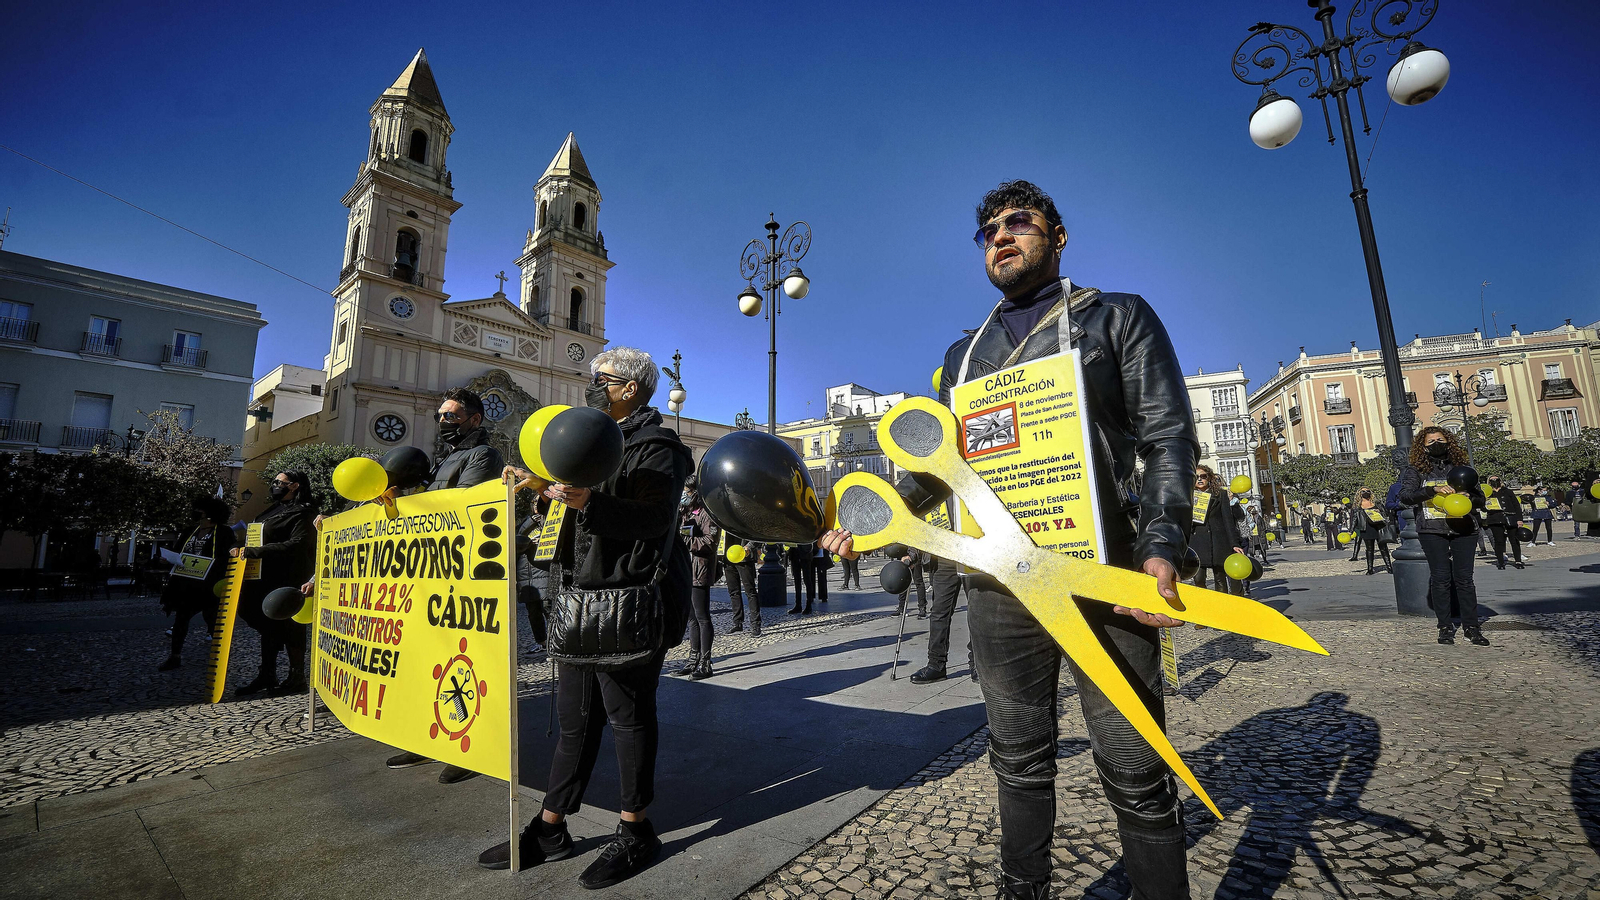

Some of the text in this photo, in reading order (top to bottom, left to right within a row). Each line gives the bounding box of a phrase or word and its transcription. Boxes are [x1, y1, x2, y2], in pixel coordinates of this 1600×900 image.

[985, 370, 1026, 392] CÁDIZ
[970, 378, 1054, 410] CONCENTRACIÓN
[1036, 391, 1073, 404] noviembre
[1053, 402, 1073, 410] Antonio
[1020, 420, 1038, 428] Frente
[1060, 411, 1077, 419] PSOE
[1032, 429, 1053, 441] 11h
[1019, 455, 1060, 469] restitución
[1062, 452, 1075, 460] del
[1018, 468, 1045, 478] imagen
[1047, 461, 1082, 475] personal
[1030, 478, 1045, 486] PGE
[1046, 475, 1059, 484] del
[1061, 472, 1081, 482] 2022
[1047, 493, 1080, 504] Estética
[1013, 506, 1064, 519] ESENCIALES
[410, 510, 465, 534] PERSONAL
[1026, 518, 1076, 533] 10% YA
[1059, 539, 1089, 550] personal
[370, 534, 465, 580] NOSOTROS
[338, 583, 348, 607] EL
[361, 583, 373, 610] AL
[374, 583, 414, 613] 21%
[428, 585, 500, 634] CÁDIZ
[357, 615, 403, 646] CENTROS
[332, 636, 400, 678] ESENCIALES!
[332, 666, 351, 705] 10%
[351, 676, 368, 716] YA
